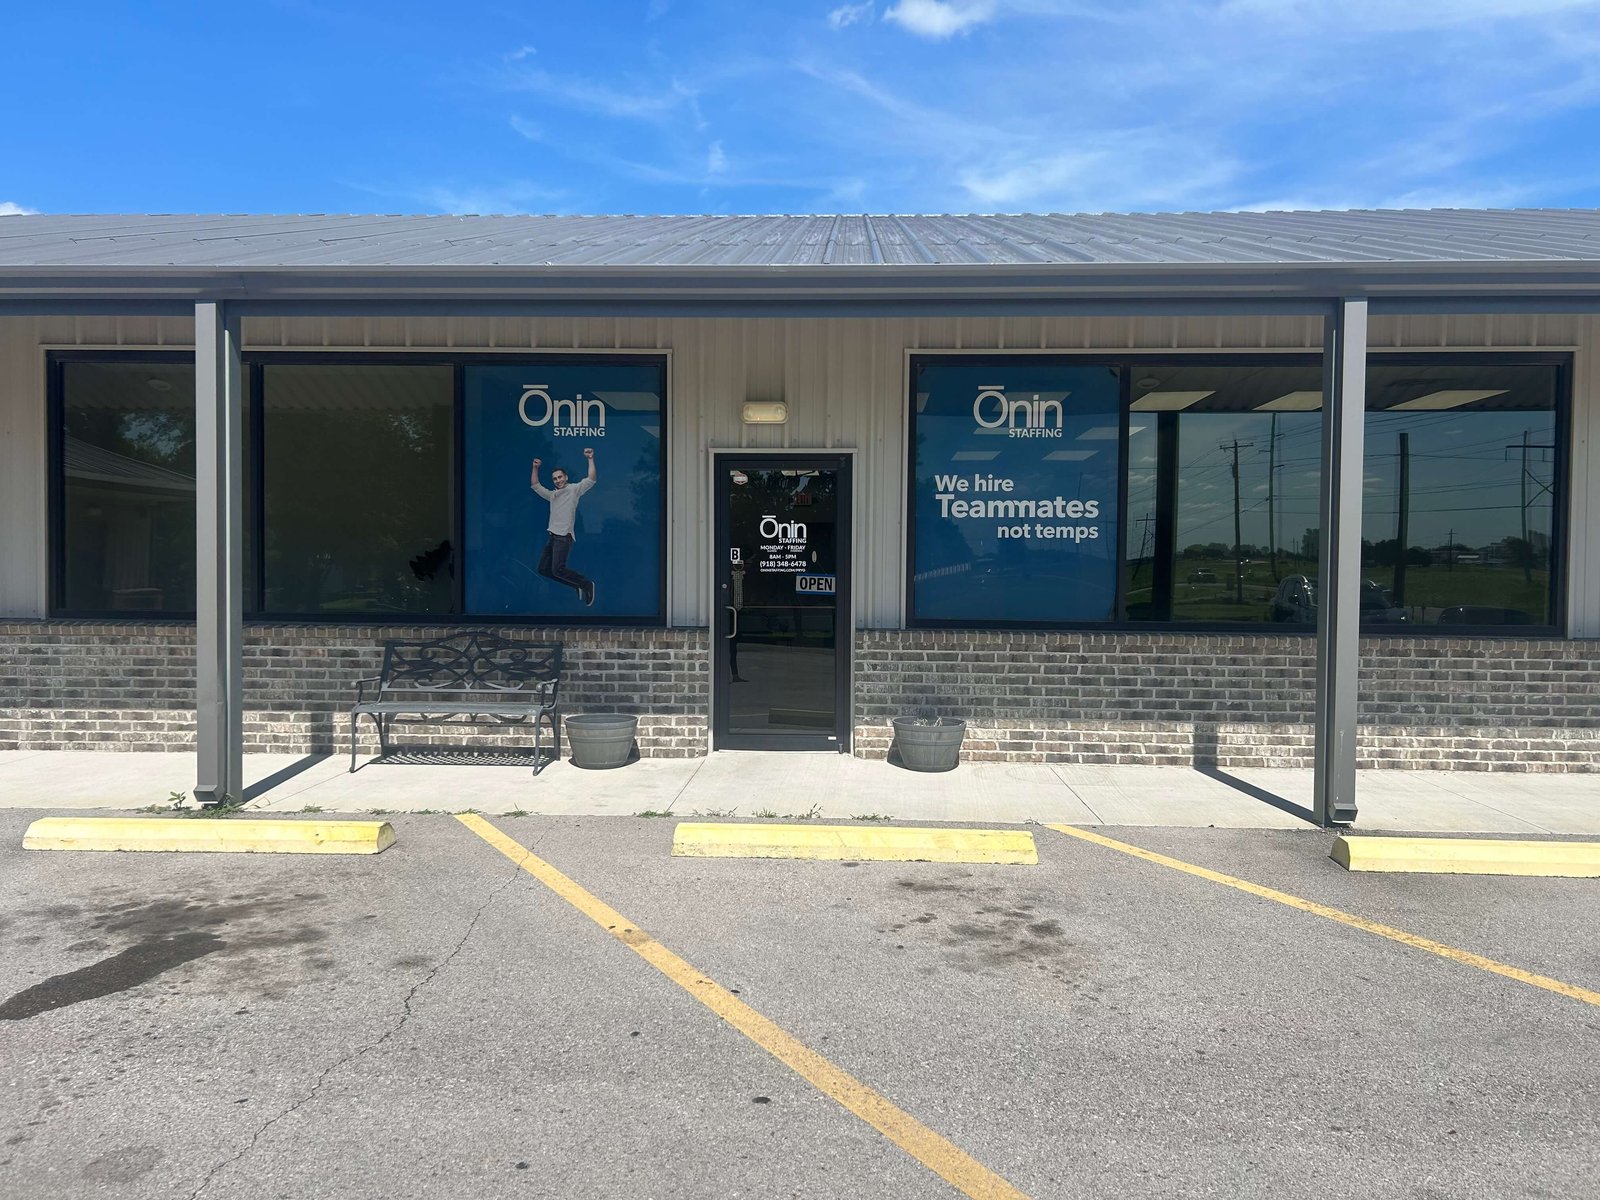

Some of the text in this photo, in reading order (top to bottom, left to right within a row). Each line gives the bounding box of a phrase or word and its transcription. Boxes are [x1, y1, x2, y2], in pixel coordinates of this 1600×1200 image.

[553, 427, 606, 437] STAFFING
[1008, 428, 1063, 438] STAFFING
[935, 474, 1014, 492] We hire
[935, 494, 1099, 519] Teammates
[997, 524, 1099, 543] not temps
[732, 550, 739, 560] B
[800, 577, 832, 592] OPEN
